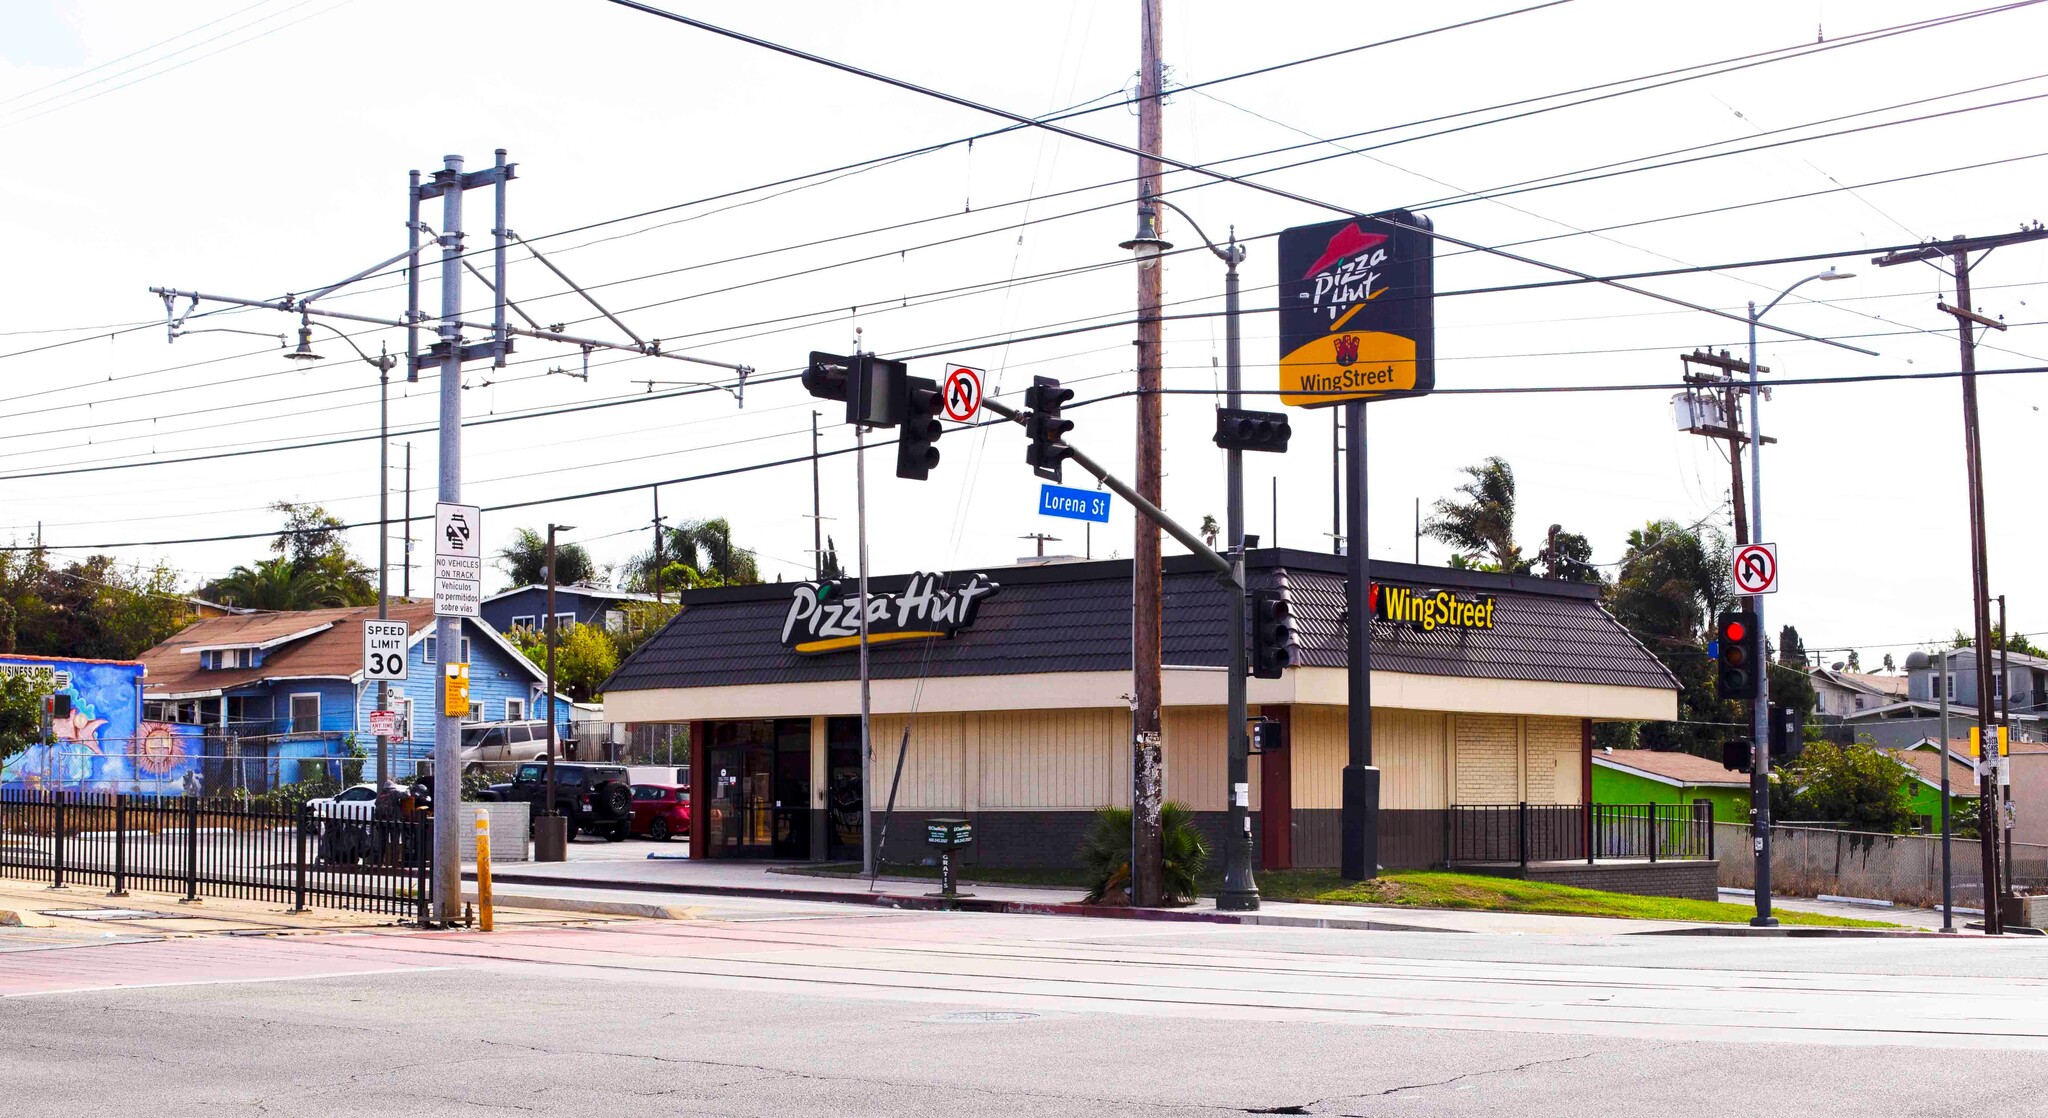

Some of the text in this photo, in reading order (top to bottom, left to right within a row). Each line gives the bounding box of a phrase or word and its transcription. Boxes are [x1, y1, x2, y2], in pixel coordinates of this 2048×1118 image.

[1313, 248, 1388, 314] Pizza
[1327, 271, 1382, 320] Hut
[1300, 365, 1394, 392] WingStreet
[1044, 491, 1105, 516] Lorena St
[436, 558, 479, 569] NO VEHICLES
[441, 569, 474, 579] ON TRACK
[436, 592, 478, 603] no permitidos
[441, 603, 459, 612] sobre
[1385, 587, 1494, 631] WingStreet
[781, 575, 990, 644] Pizza Hut
[367, 625, 405, 636] SPEED
[371, 639, 401, 649] LIMIT
[369, 652, 403, 675] 30
